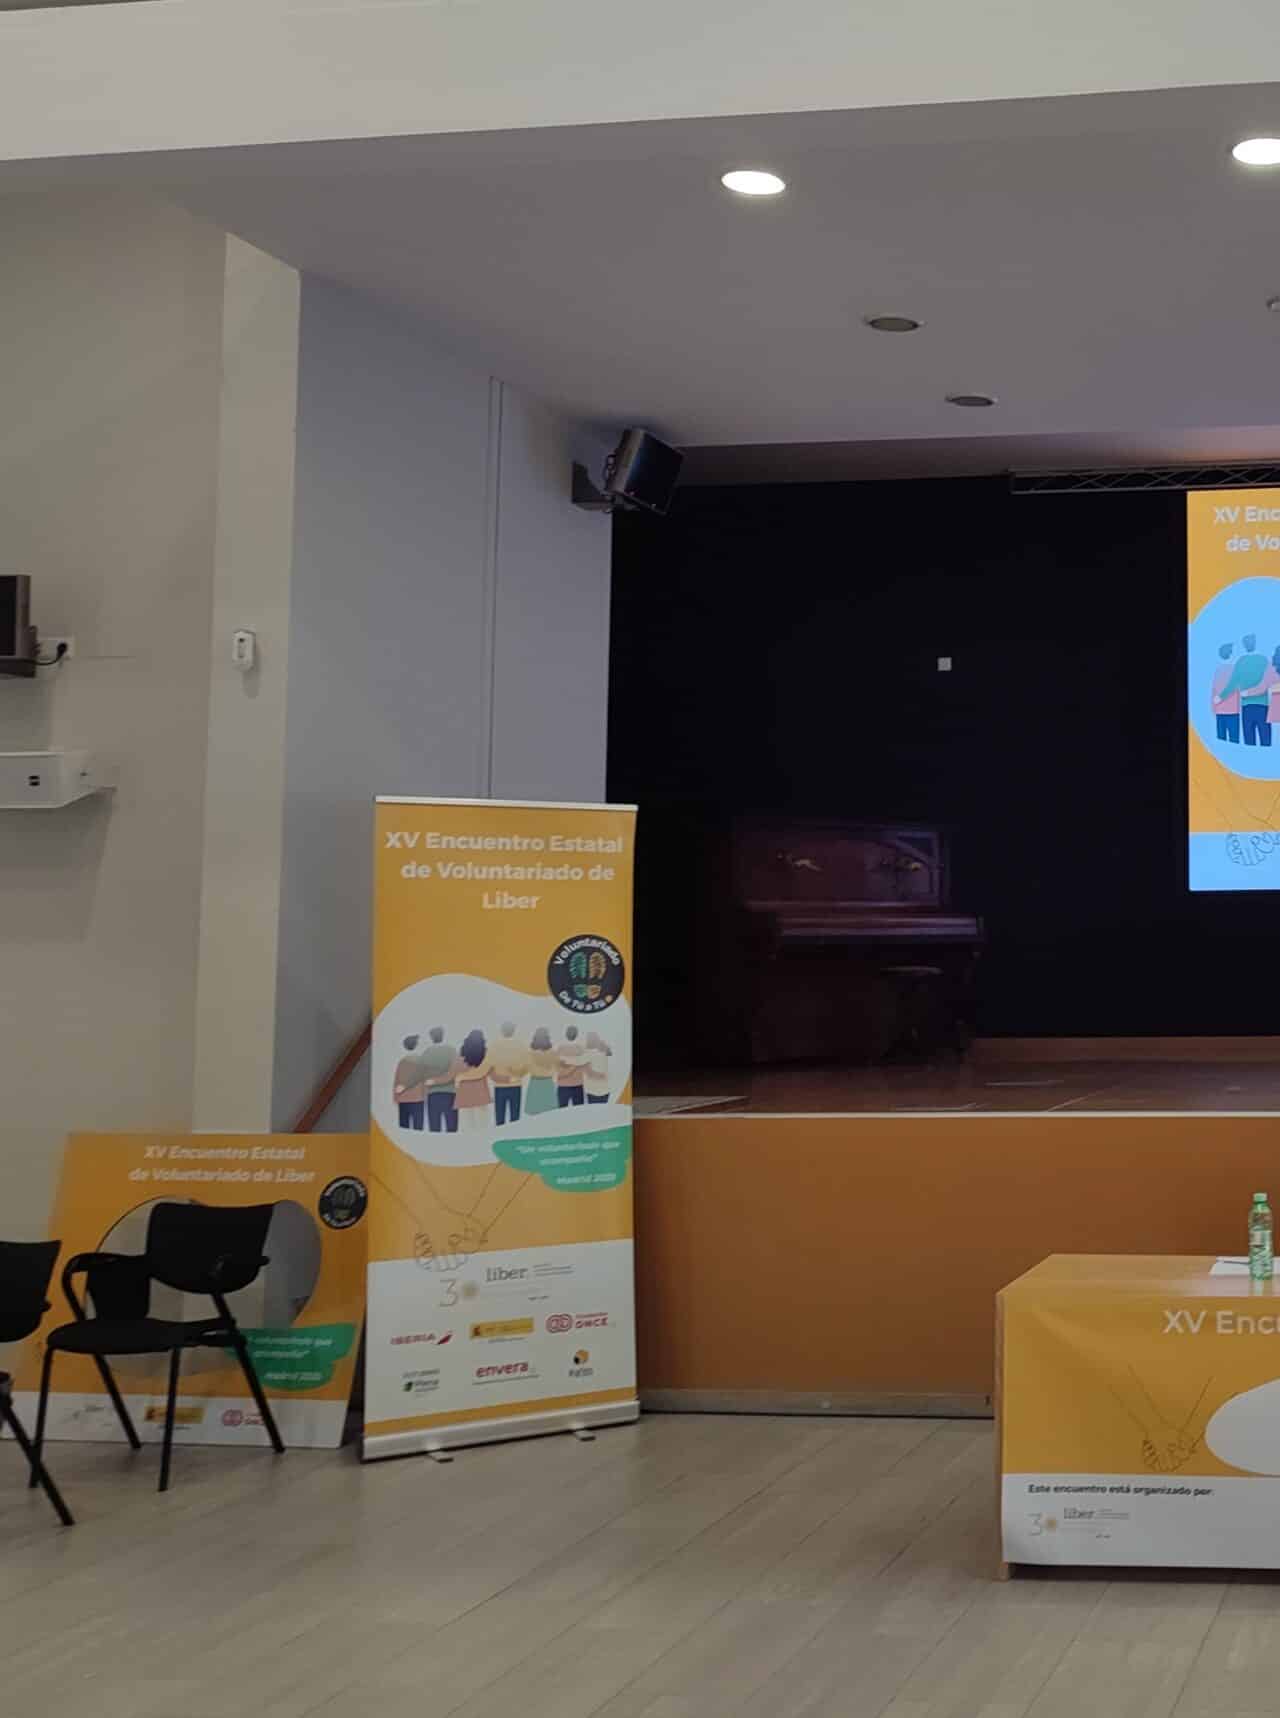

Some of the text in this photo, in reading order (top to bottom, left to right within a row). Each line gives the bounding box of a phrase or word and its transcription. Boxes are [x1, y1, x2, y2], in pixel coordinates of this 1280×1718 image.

[1214, 506, 1241, 524] XV
[1226, 535, 1252, 552] de
[385, 831, 624, 854] XV Encuentro Estatal
[401, 861, 616, 881] de Voluntariado de
[482, 891, 541, 910] Liber
[553, 937, 621, 966] Voluntariado
[169, 1146, 250, 1160] Encuentro
[250, 1147, 305, 1160] Estatal
[151, 1168, 250, 1183] Voluntariado
[485, 1265, 529, 1283] liber
[1163, 1310, 1207, 1334] XV
[390, 1332, 437, 1346] IBERIA
[476, 1362, 529, 1377] envera
[1028, 1484, 1052, 1494] Este
[1053, 1485, 1107, 1494] encuentro
[1109, 1485, 1131, 1494] está
[1133, 1486, 1191, 1497] organizado
[1063, 1507, 1095, 1520] liber
